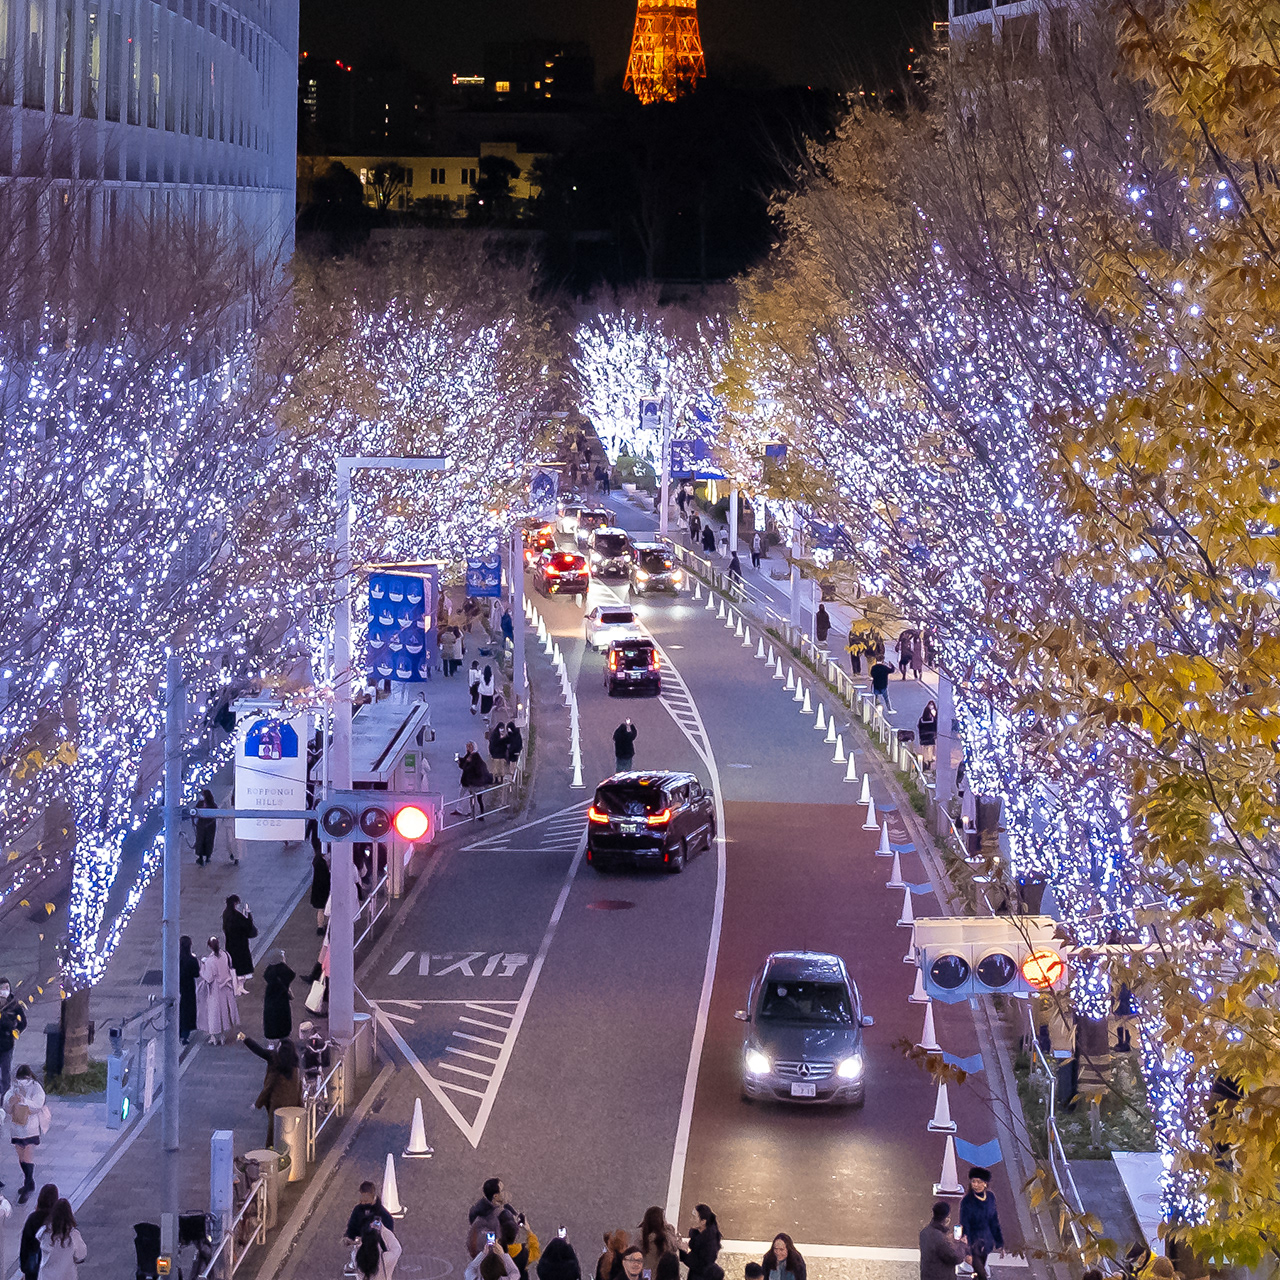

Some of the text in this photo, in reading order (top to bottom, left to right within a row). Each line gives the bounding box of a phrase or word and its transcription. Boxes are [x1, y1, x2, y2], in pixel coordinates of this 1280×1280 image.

[246, 787, 295, 796] ROPPONGI
[255, 798, 284, 806] HILLS
[255, 819, 283, 827] 2022
[387, 951, 531, 977] バス停
